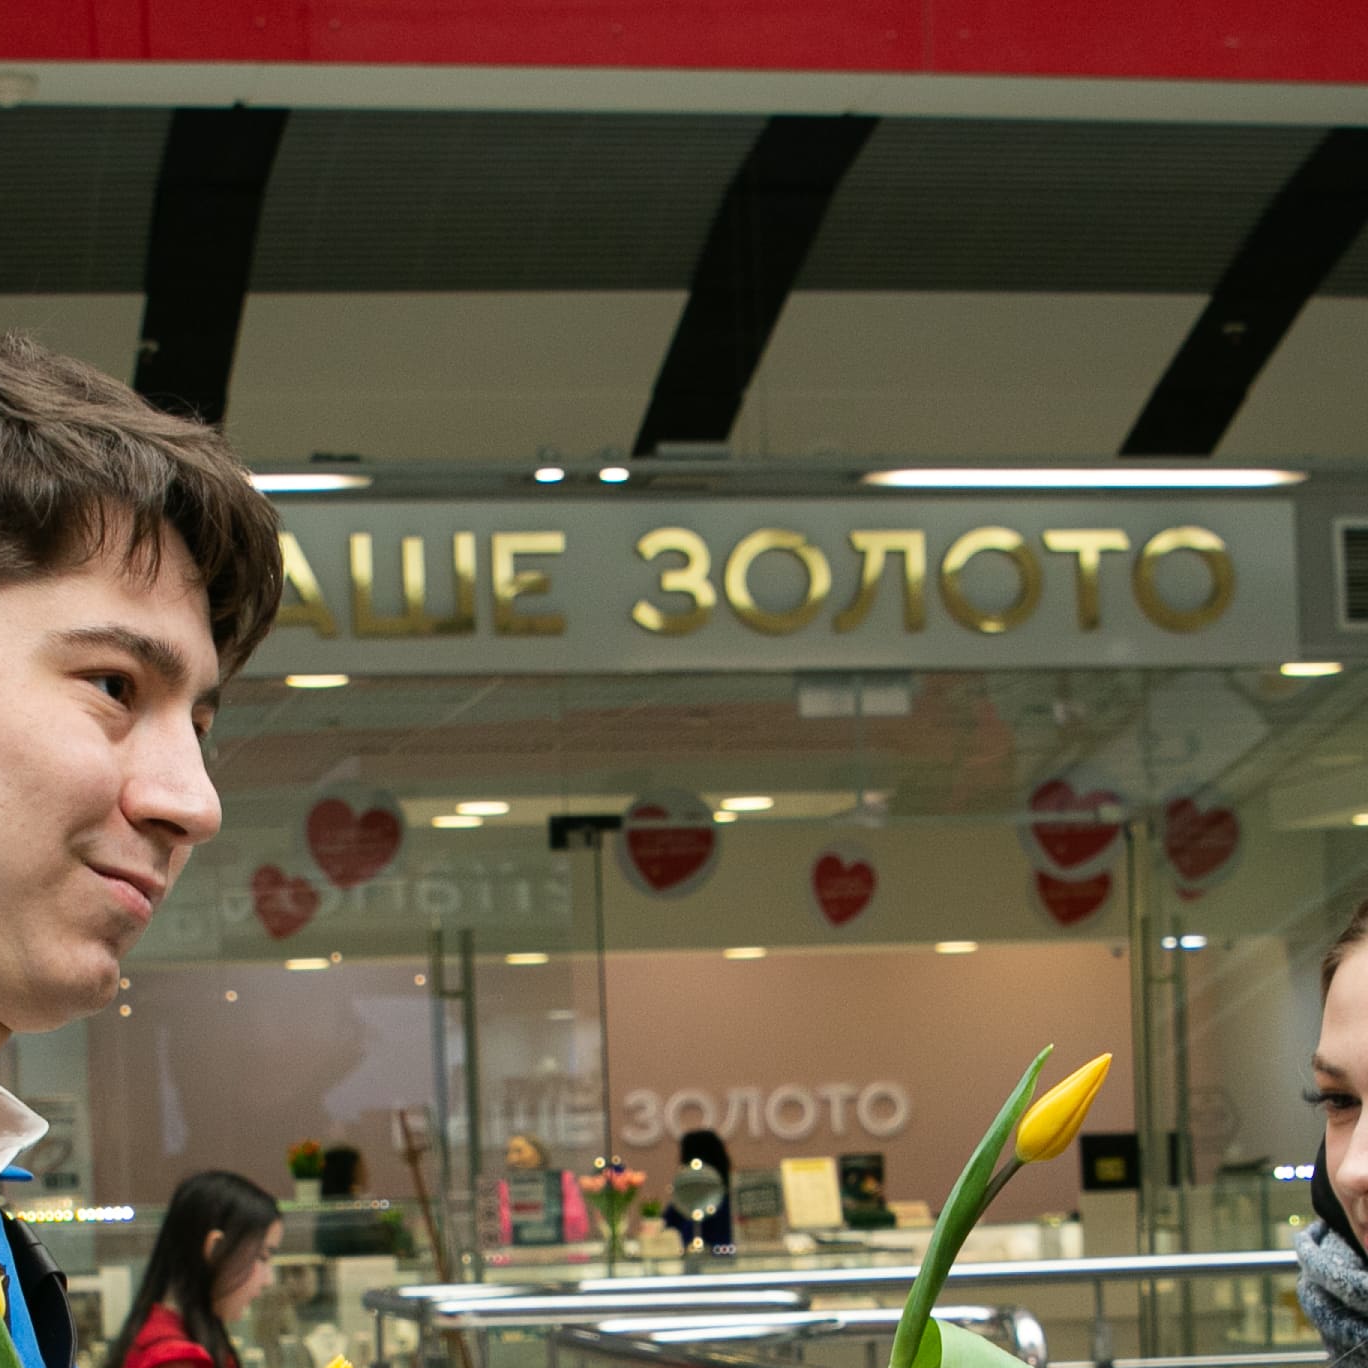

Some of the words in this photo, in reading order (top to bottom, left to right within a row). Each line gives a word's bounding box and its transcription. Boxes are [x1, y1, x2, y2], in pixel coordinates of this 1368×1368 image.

[275, 530, 567, 640] АШЕ
[632, 525, 1237, 636] ЗОЛОТО
[621, 1081, 911, 1148] ЗОЛОТО
